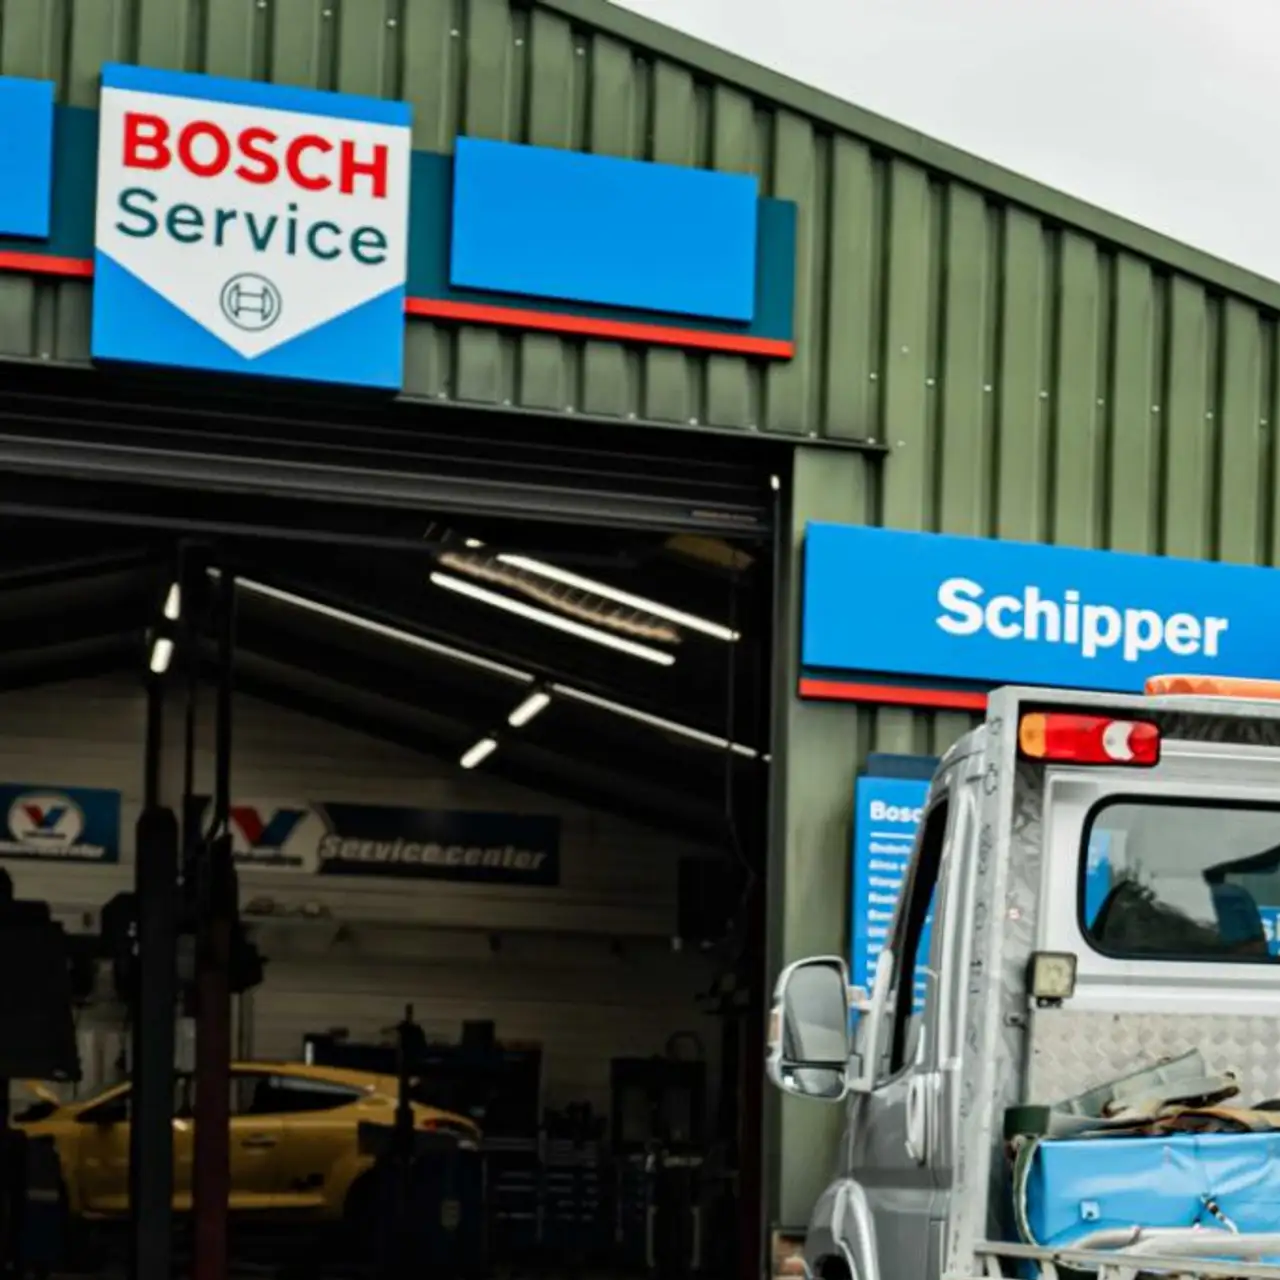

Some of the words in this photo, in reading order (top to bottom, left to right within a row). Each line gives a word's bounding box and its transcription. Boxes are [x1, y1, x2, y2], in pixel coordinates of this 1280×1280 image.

[122, 112, 389, 199] BOSCH
[116, 187, 388, 266] Service
[936, 578, 1228, 661] Schipper
